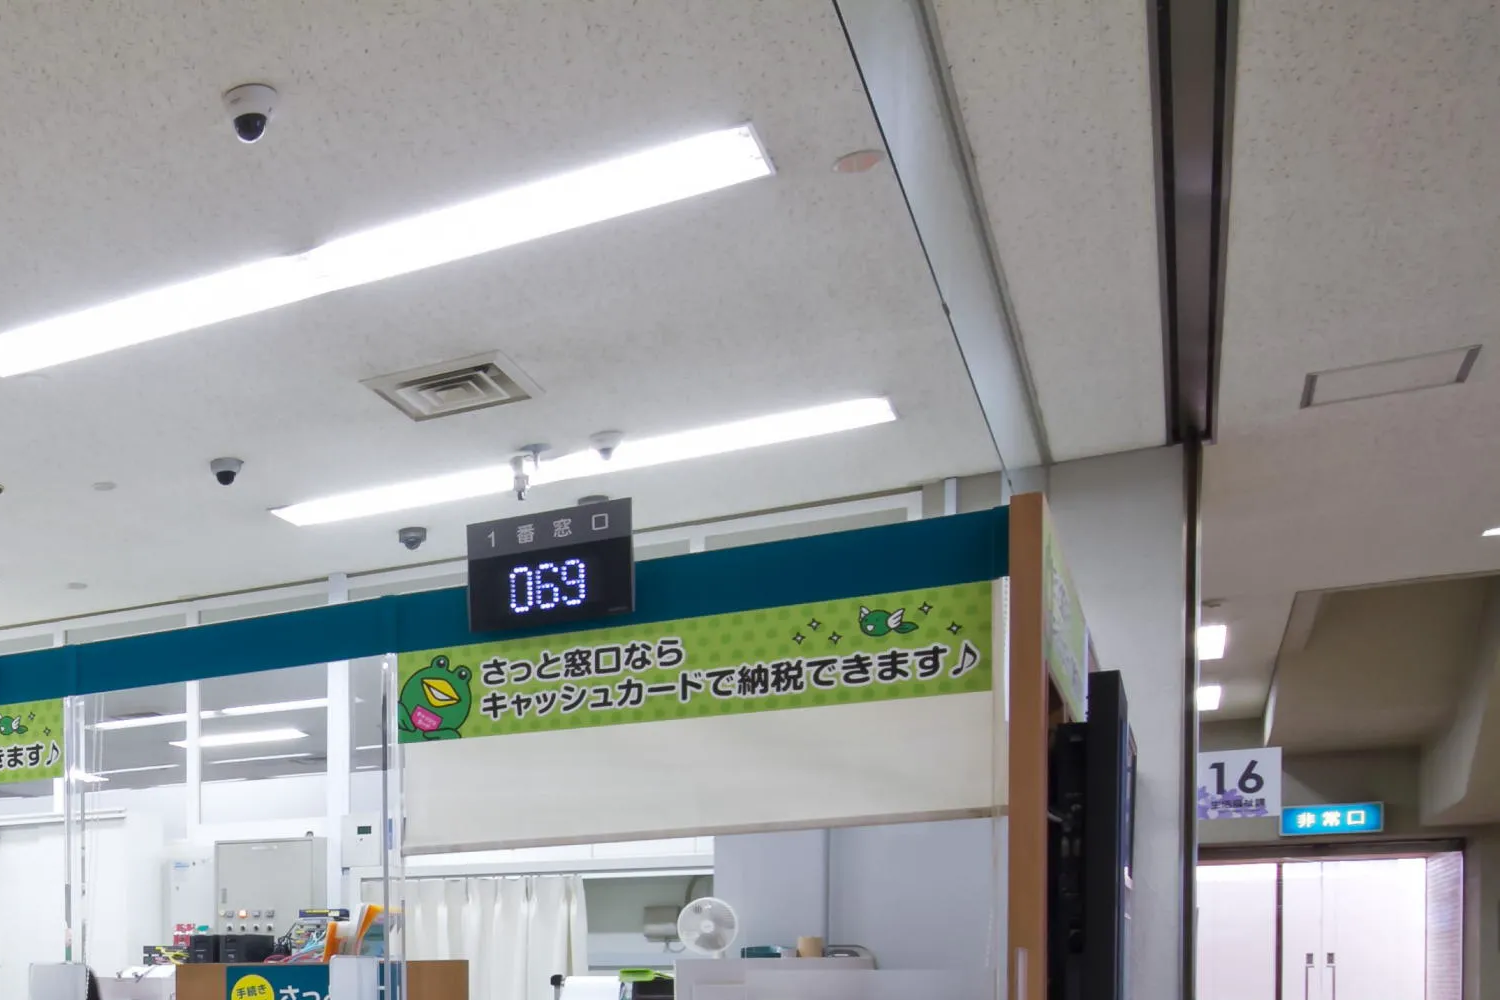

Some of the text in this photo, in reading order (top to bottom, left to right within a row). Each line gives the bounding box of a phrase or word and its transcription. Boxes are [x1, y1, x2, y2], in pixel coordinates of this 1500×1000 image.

[487, 513, 609, 548] 1番窓口
[508, 559, 585, 613] 069
[481, 639, 683, 686] さっと窓口なら
[1208, 759, 1265, 795] 16
[1296, 810, 1366, 829] 非常口
[236, 983, 267, 1000] 手続き
